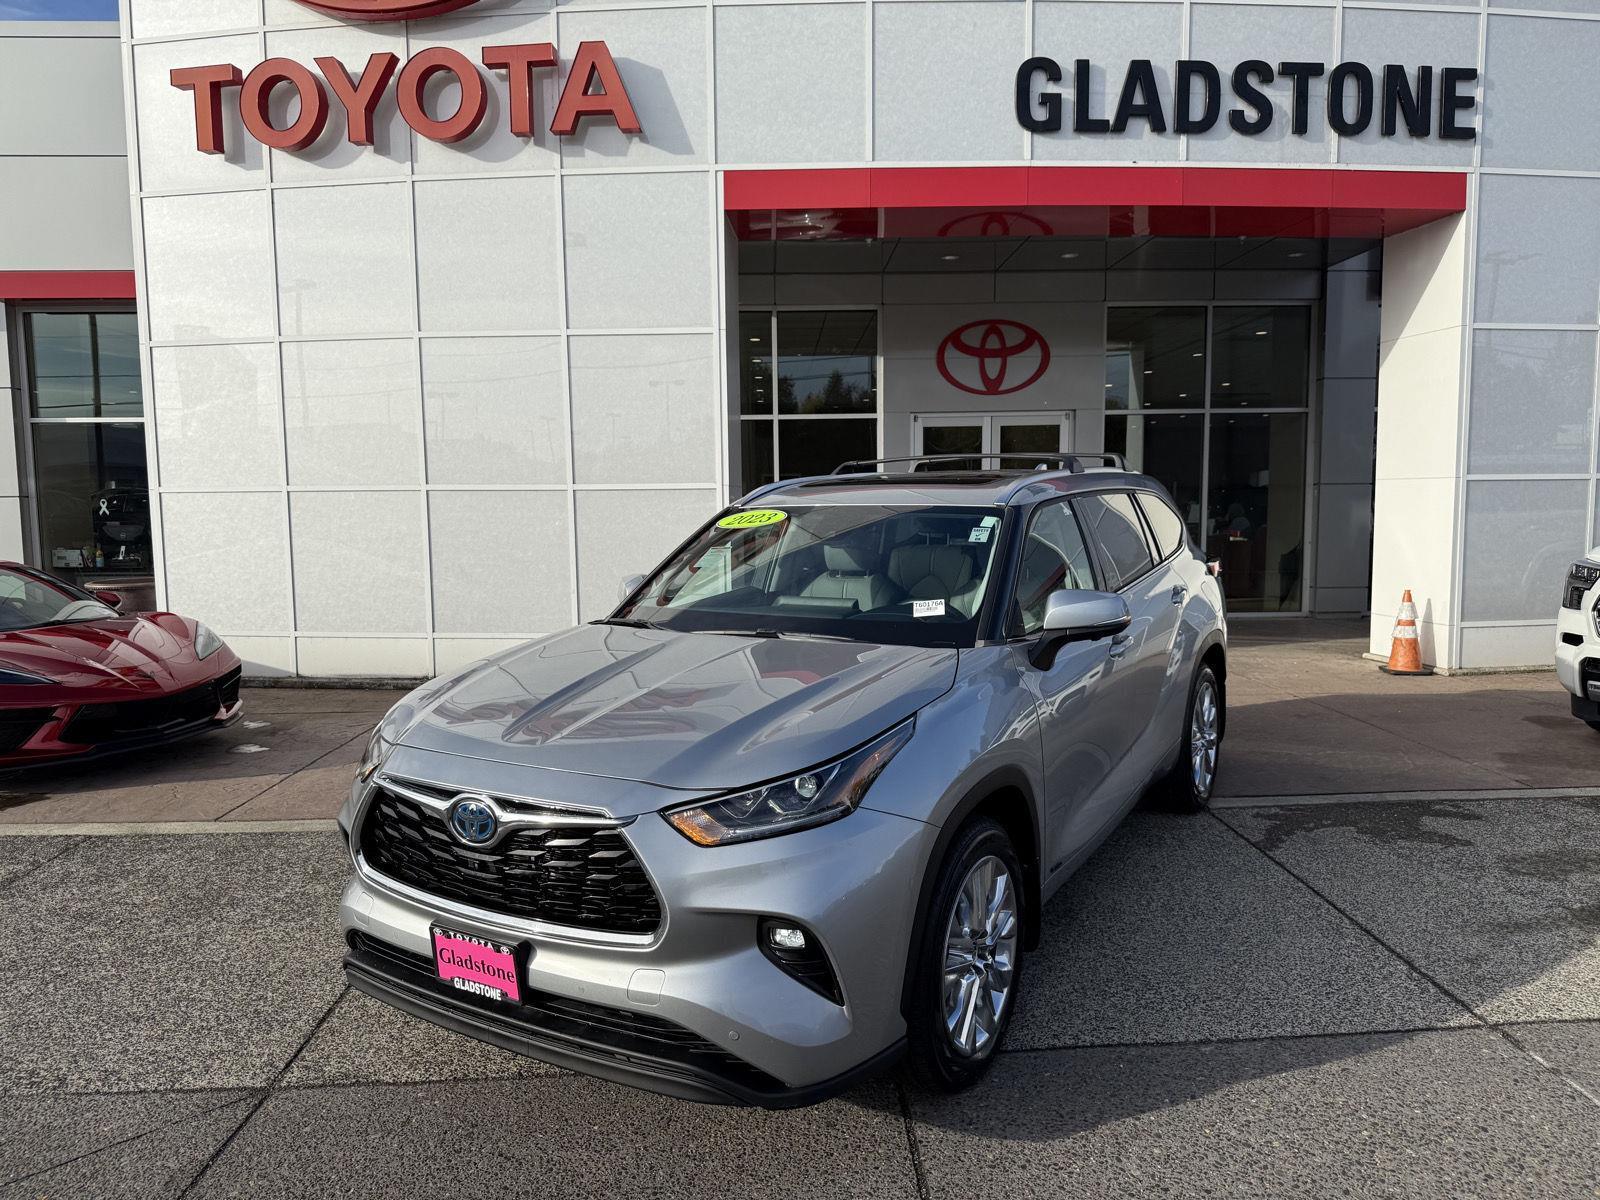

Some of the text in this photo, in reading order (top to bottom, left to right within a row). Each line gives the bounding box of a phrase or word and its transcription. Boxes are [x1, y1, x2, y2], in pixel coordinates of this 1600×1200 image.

[170, 40, 642, 155] TOYOTA
[1014, 56, 1478, 140] GLADSTONE
[726, 512, 778, 526] 2023
[448, 931, 495, 951] TOYOTA
[438, 947, 516, 984] Gladstone
[453, 977, 502, 1001] GLADSTONE
